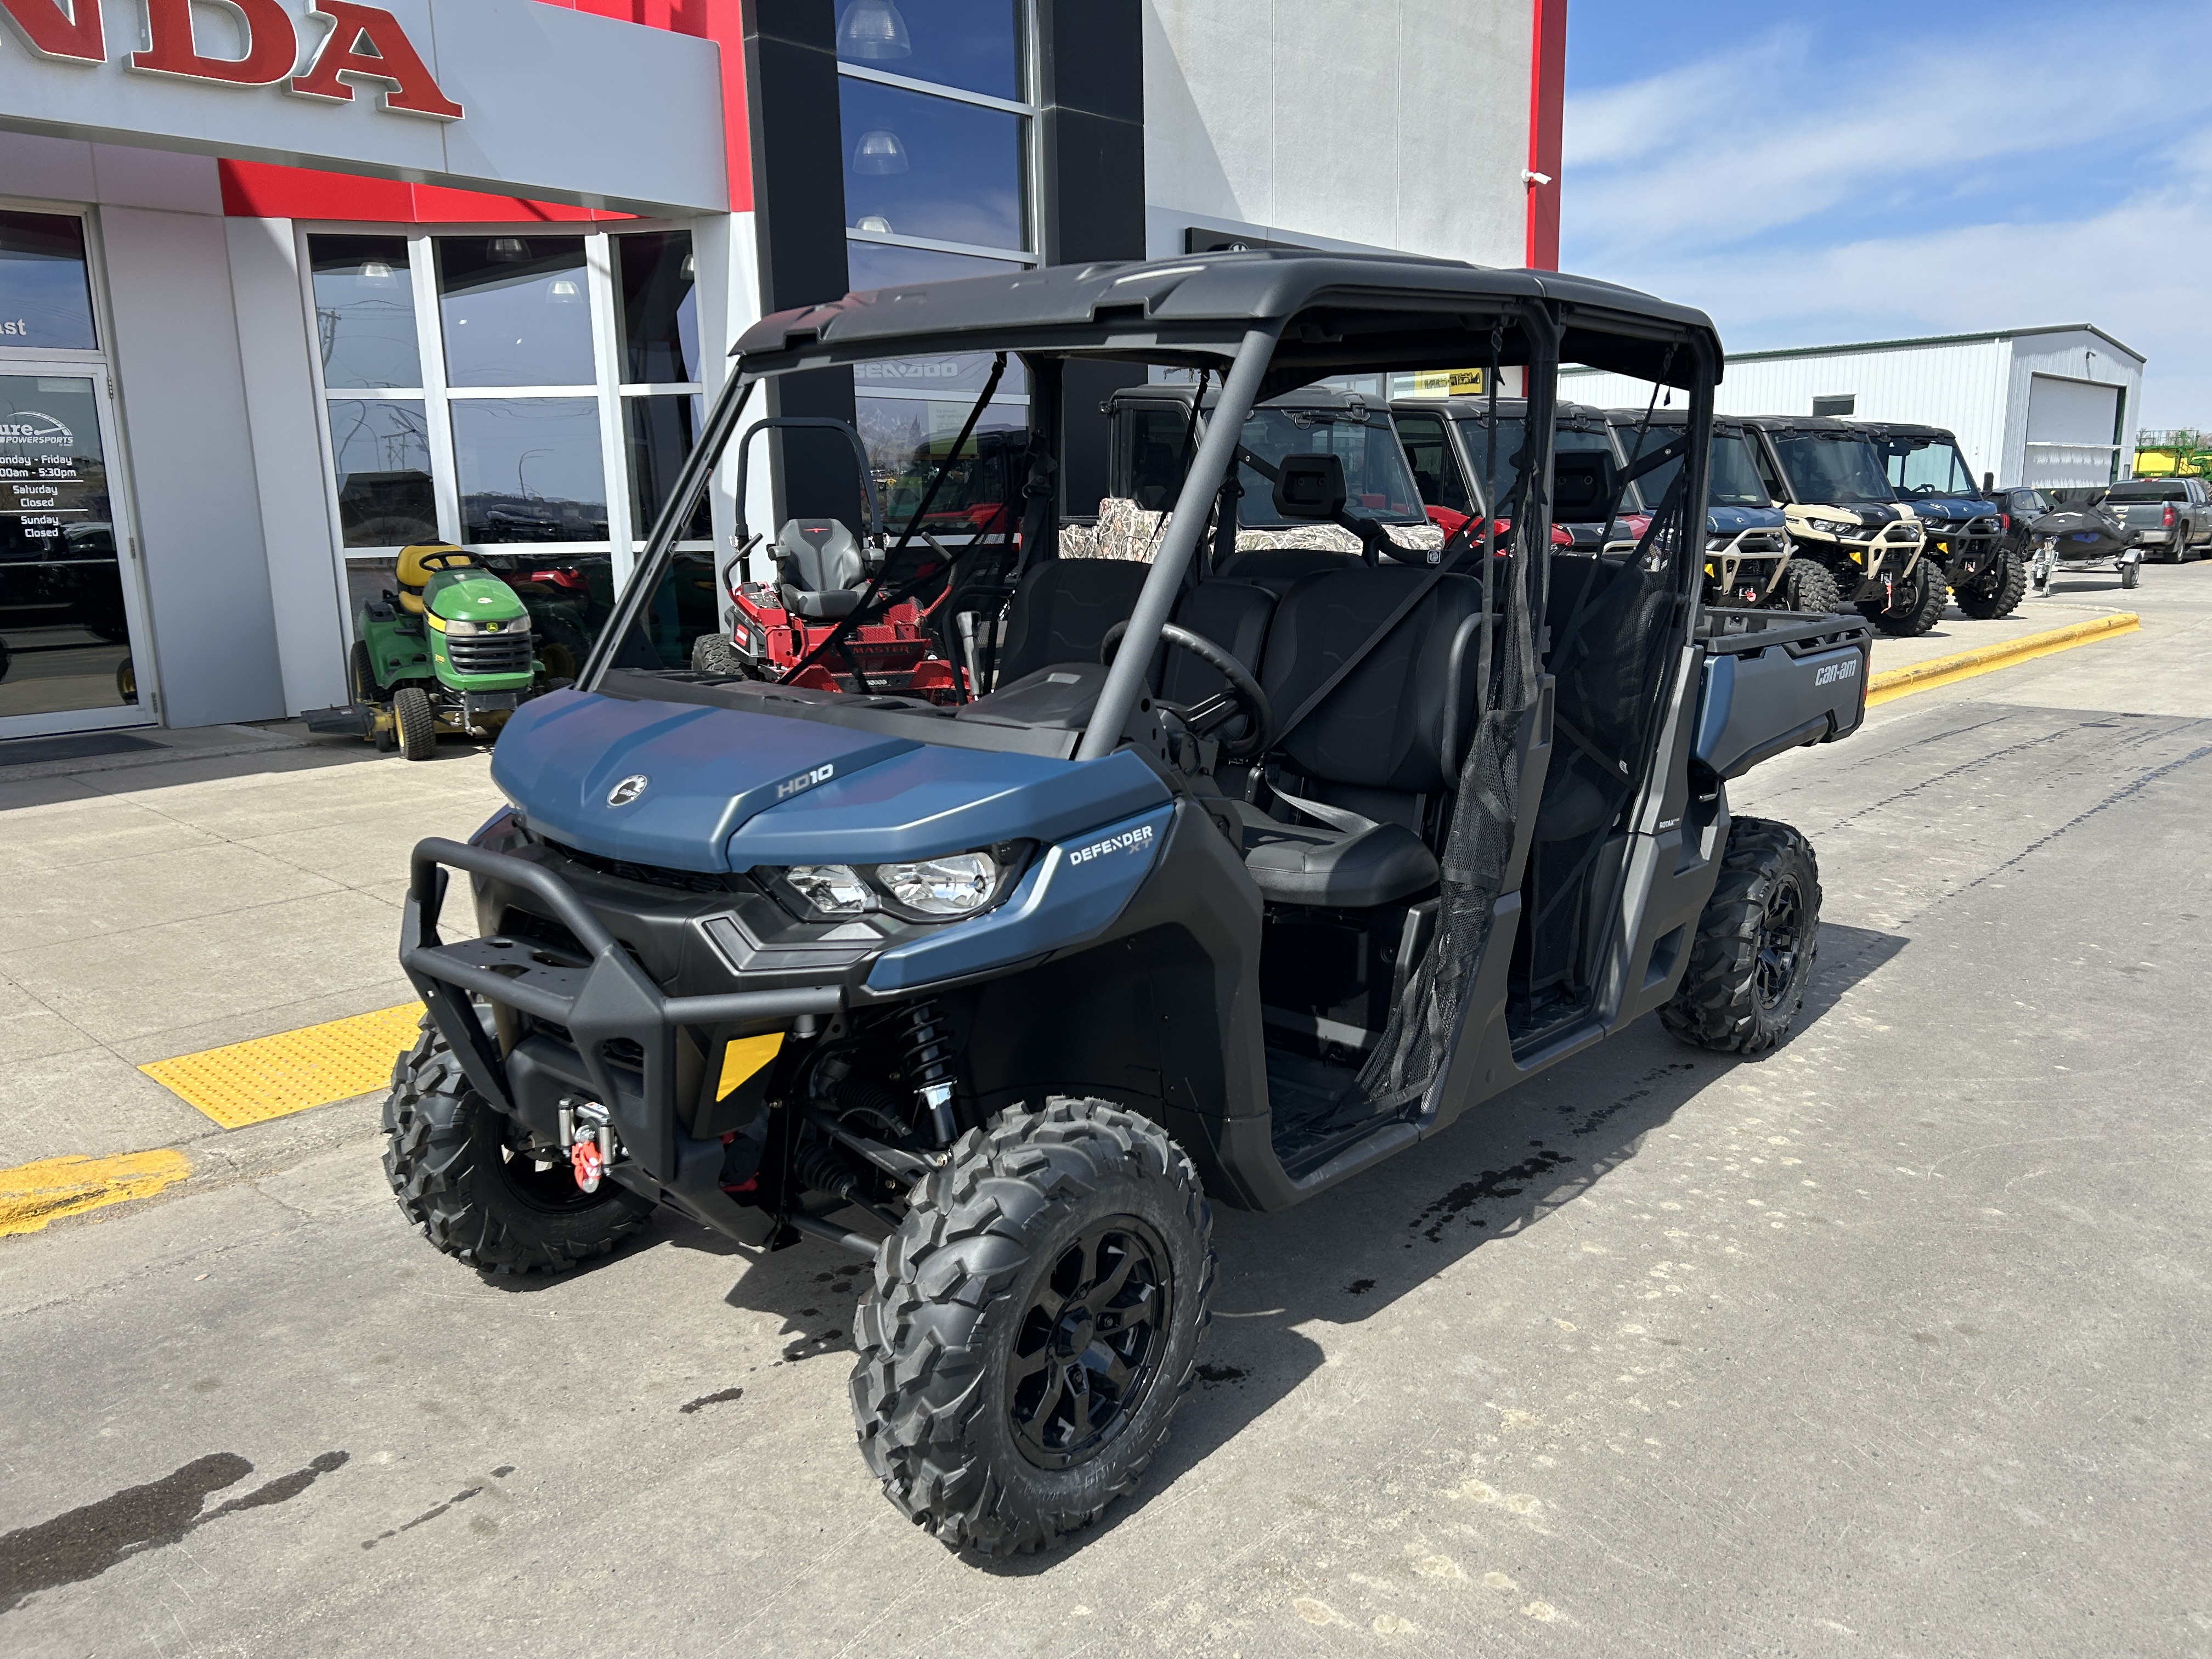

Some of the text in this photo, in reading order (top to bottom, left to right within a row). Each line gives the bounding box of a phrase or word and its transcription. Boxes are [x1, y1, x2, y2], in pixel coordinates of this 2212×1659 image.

[41, 455, 72, 466] Friday
[38, 467, 76, 478] 5:30pm
[13, 485, 58, 496] Saturday
[20, 498, 54, 507] Closed
[21, 515, 59, 526] Sunday
[25, 527, 58, 538] Closed
[1815, 659, 1857, 686] can-am
[776, 763, 833, 799] HD10
[1070, 825, 1153, 866] DEFENDER
[1128, 838, 1153, 854] XT
